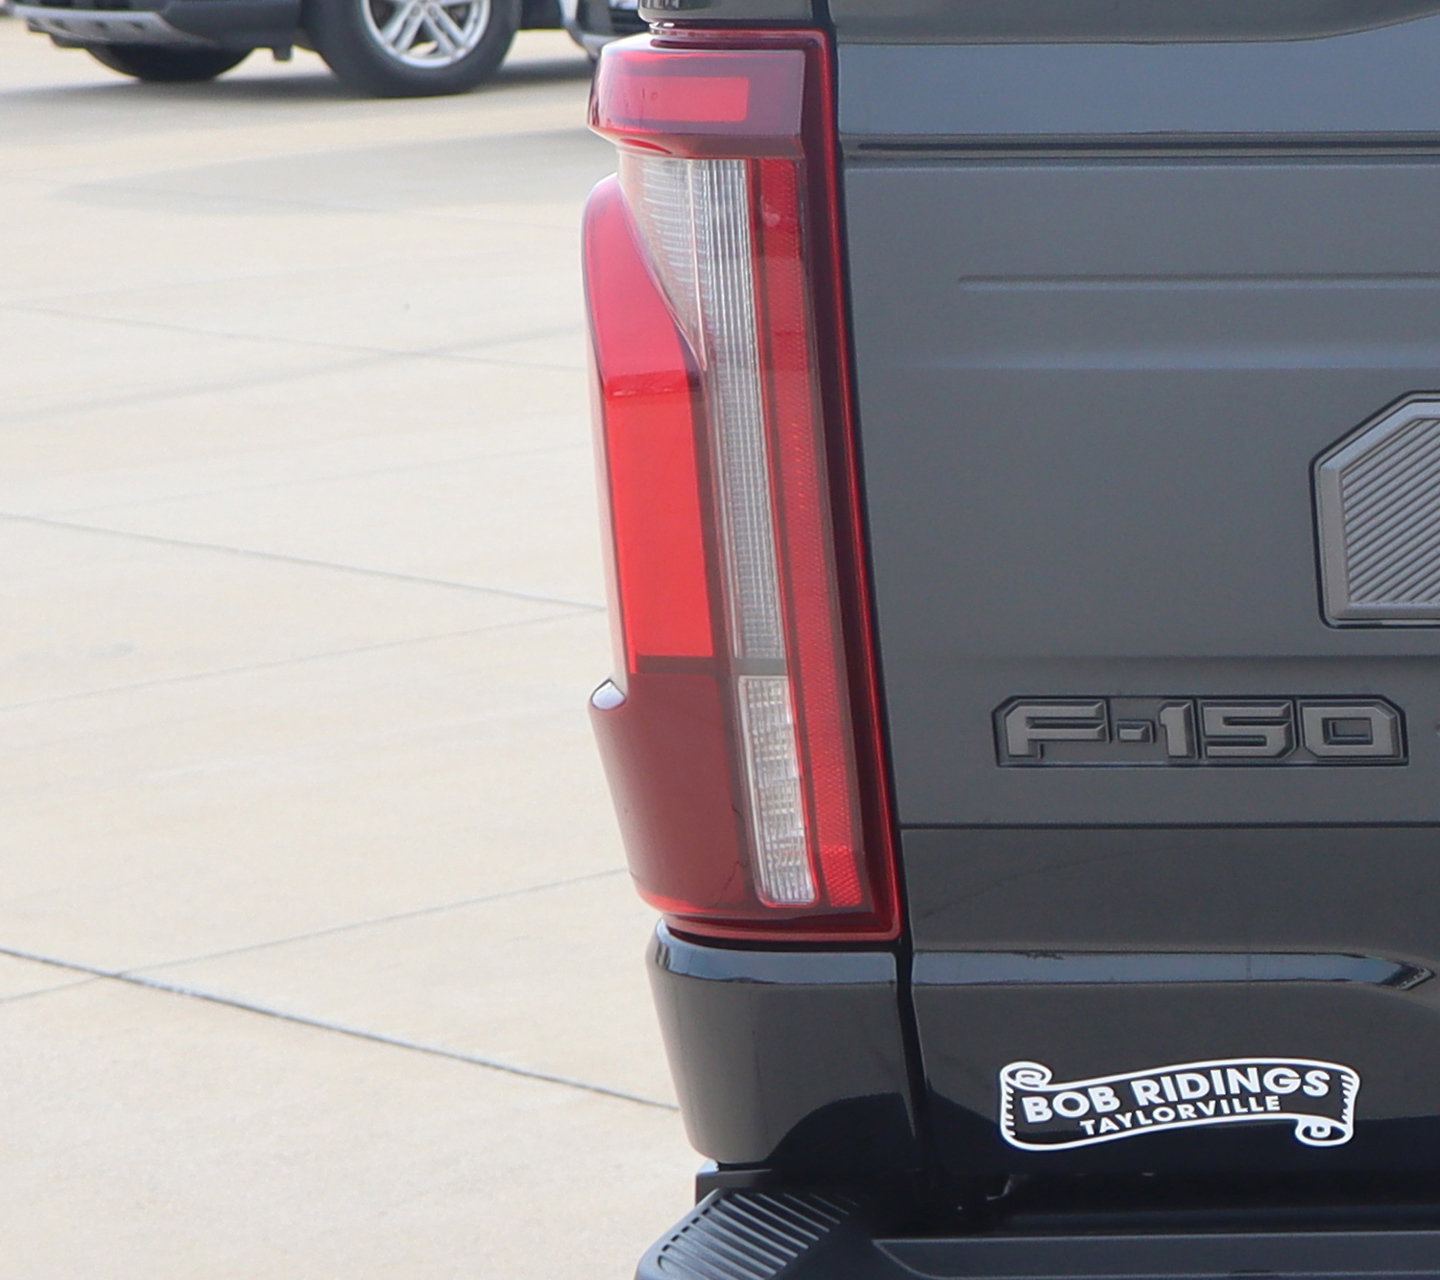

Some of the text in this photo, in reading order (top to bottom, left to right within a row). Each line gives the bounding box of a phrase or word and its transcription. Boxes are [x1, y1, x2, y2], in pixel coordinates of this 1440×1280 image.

[992, 694, 1410, 767] F-150
[1022, 1066, 1331, 1124] BOB RIDINGS
[1080, 1095, 1281, 1136] TAYLORVILLE
